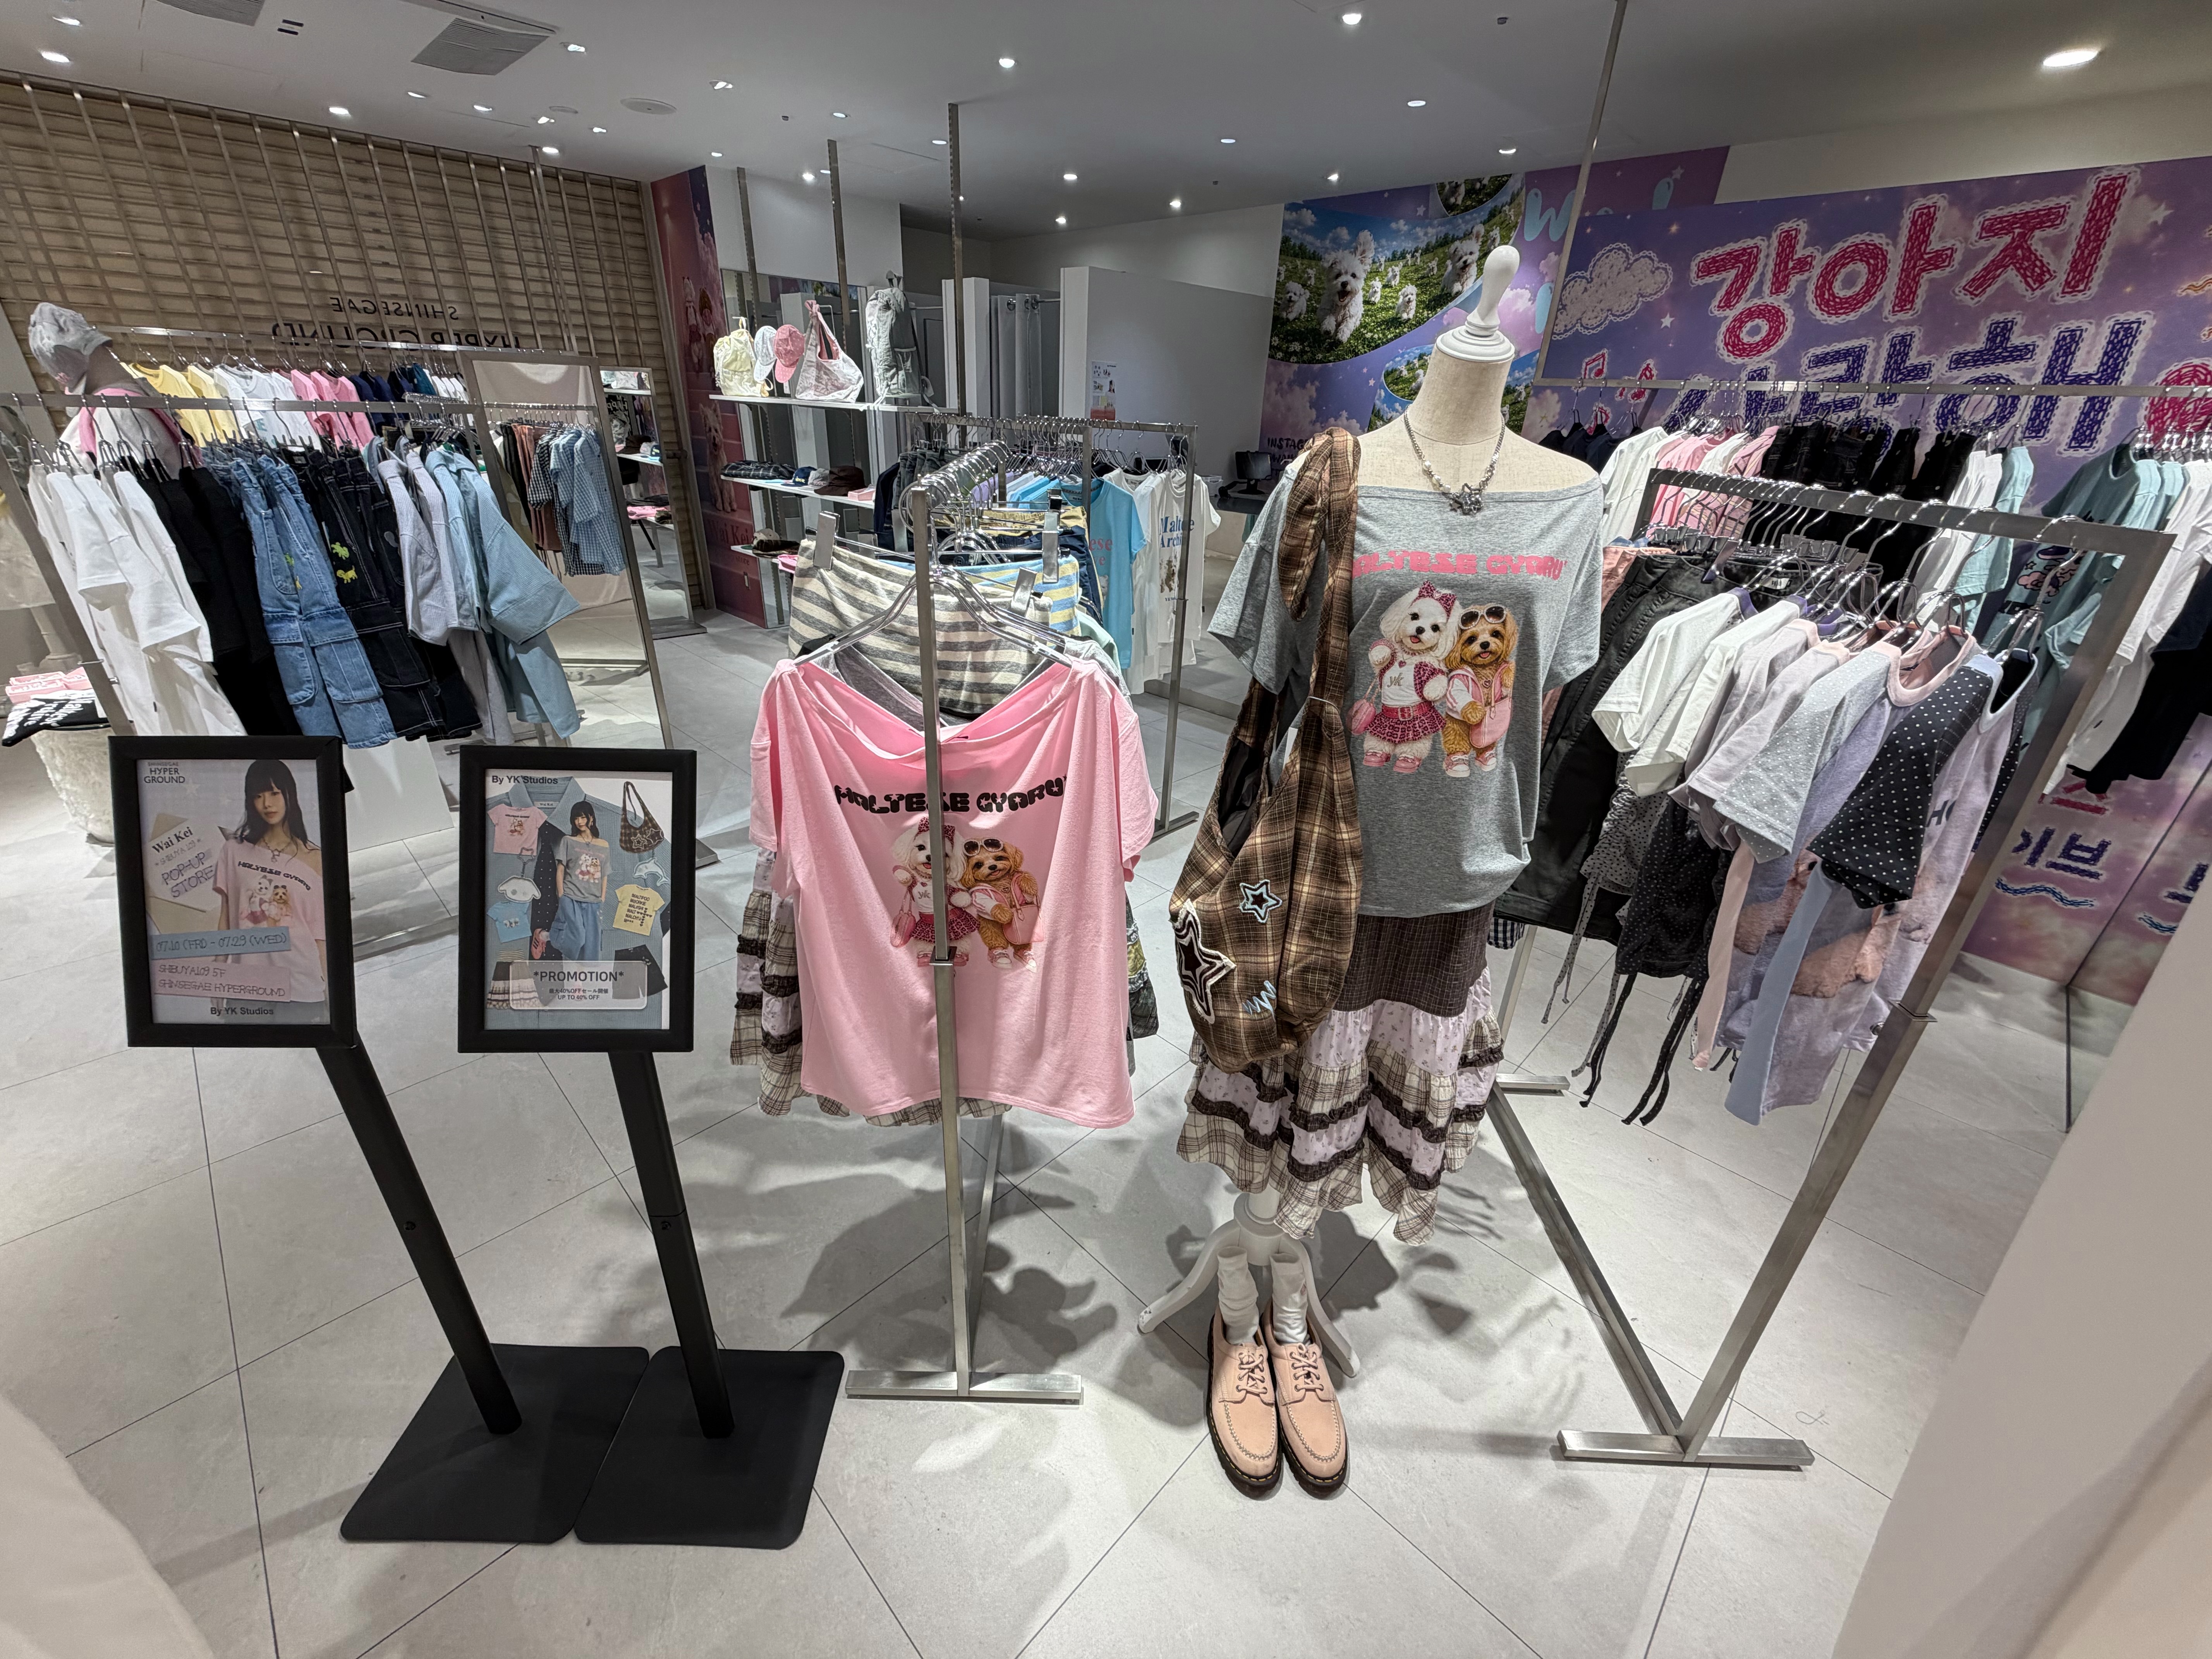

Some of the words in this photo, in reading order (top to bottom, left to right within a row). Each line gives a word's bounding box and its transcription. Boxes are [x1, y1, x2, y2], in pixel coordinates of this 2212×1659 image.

[1697, 173, 2128, 359] 강아지
[730, 525, 749, 545] Kei
[1353, 550, 1477, 579] ALTESE
[1387, 672, 1404, 688] yk
[491, 775, 504, 784] By
[522, 776, 558, 784] Studios
[152, 836, 174, 854] Wai
[174, 826, 194, 843] Kei
[161, 852, 206, 885] POP-UP
[171, 865, 215, 898] STORE
[918, 890, 931, 899] yk
[156, 941, 180, 952] 07.10
[183, 938, 207, 950] (FRI)
[218, 935, 247, 947] 07.29
[249, 932, 287, 946] (WED)
[212, 968, 227, 978] 5F
[158, 979, 211, 991] SHINSEGAE
[214, 983, 285, 997] HYPERGROUND
[210, 1007, 221, 1017] By
[240, 1007, 274, 1015] Studios
